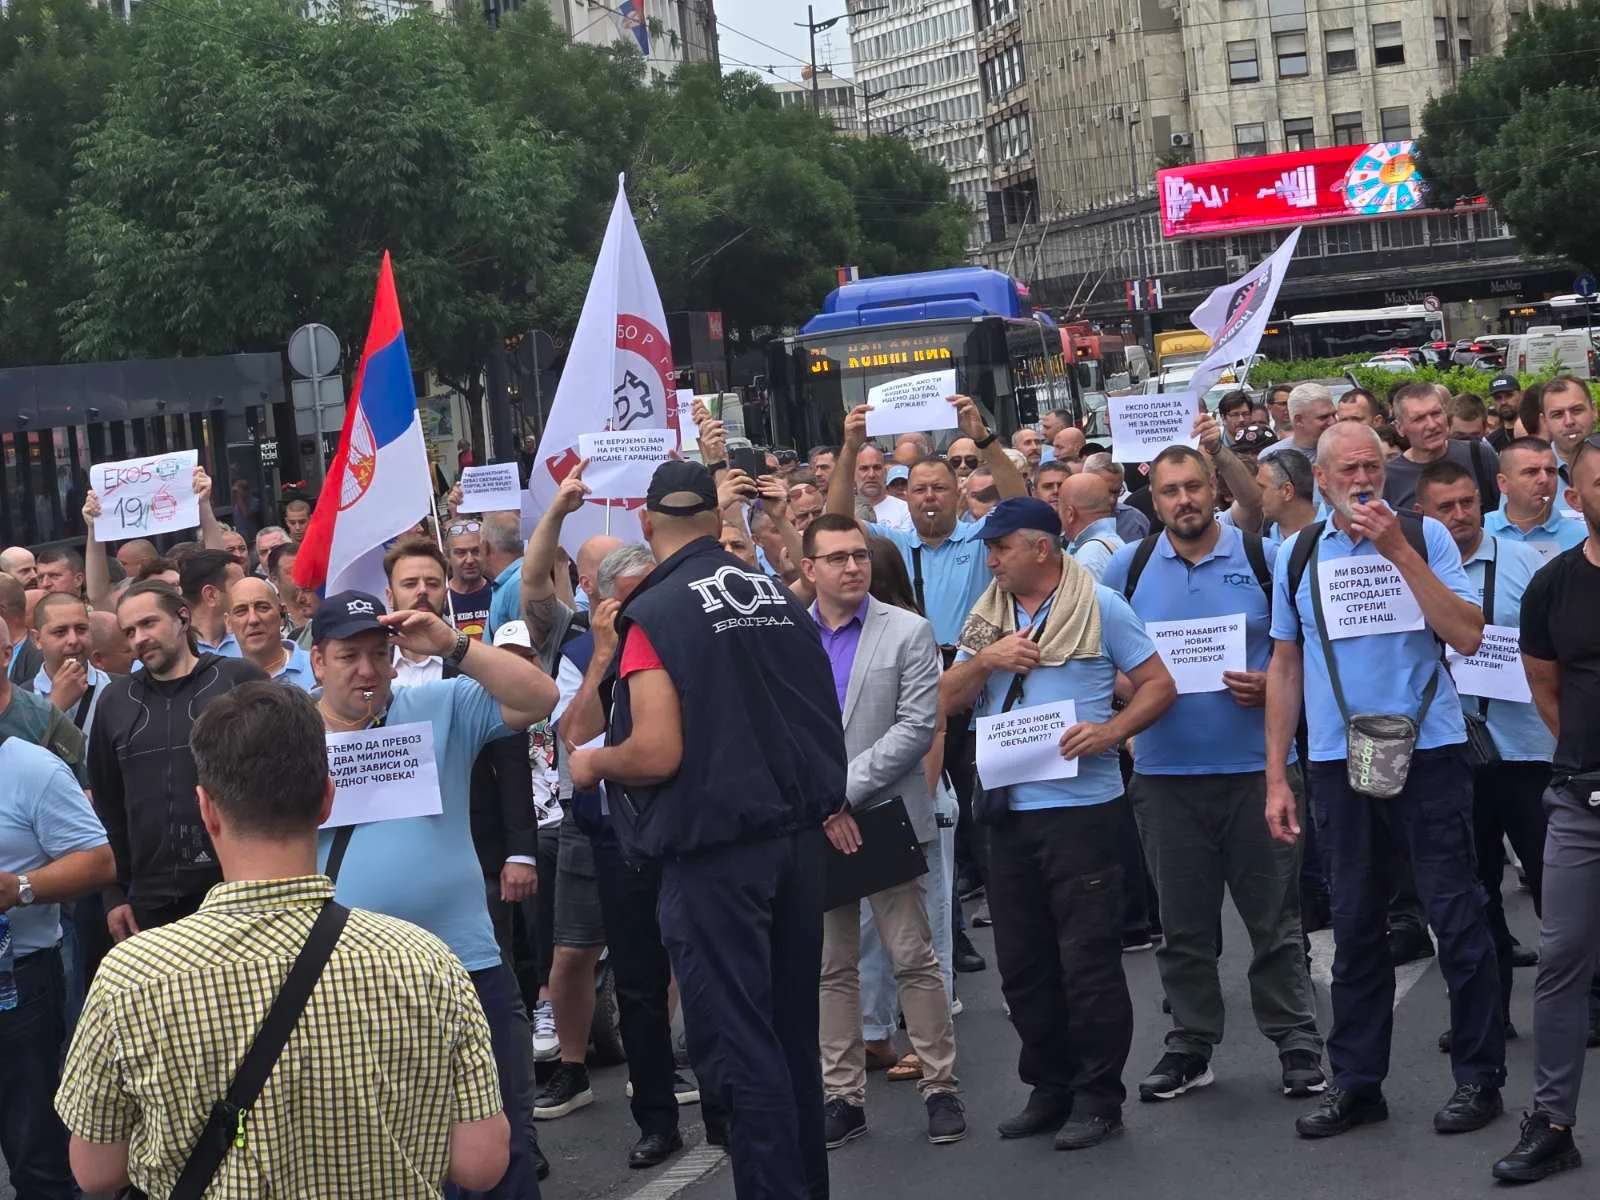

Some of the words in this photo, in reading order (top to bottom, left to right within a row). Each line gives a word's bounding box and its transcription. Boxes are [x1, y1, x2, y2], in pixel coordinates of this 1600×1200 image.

[617, 324, 654, 345] БОР
[921, 391, 940, 399] ВРХА
[1150, 402, 1171, 410] ПЛАН
[1119, 411, 1159, 420] ПРЕПОРОД
[1150, 418, 1183, 427] ПУЊЕЊЕ
[1135, 427, 1179, 436] ПРИВАТНИХ
[593, 438, 605, 446] НЕ
[606, 437, 647, 445] ВЕРУЈЕМО
[590, 455, 621, 463] ПИСАНЕ
[1334, 568, 1349, 577] МИ
[1350, 564, 1393, 575] ВОЗИМО
[1374, 577, 1388, 585] ВИ
[1390, 575, 1401, 583] ГА
[1330, 587, 1402, 603] РАСПРОДАЈЕТЕ
[1346, 601, 1387, 613] СТРЕЛИ!
[1339, 616, 1357, 626] ГСП
[1358, 615, 1369, 625] ЈЕ
[1370, 613, 1397, 623] НАШ.
[1156, 629, 1184, 638] ХИТНО
[1185, 625, 1227, 636] НАБАВИТЕ
[1184, 637, 1213, 646] НОВИХ
[1170, 644, 1226, 656] АУТОНОМНИХ
[1480, 642, 1521, 654] РОЂЕНДА
[1479, 651, 1489, 659] ТИ
[1491, 653, 1517, 663] НАШИ
[991, 721, 1006, 731] ГДЕ
[1006, 719, 1015, 728] ЈЕ
[1016, 717, 1032, 726] 300
[1033, 711, 1061, 722] НОВИХ
[987, 727, 1028, 741] АУТОБУСА
[1029, 723, 1049, 733] КОЈЕ
[1050, 720, 1066, 730] СТЕ
[327, 742, 363, 754] ЕЋЕМО
[365, 740, 380, 751] ДА
[382, 734, 422, 748] ПРЕВОЗ
[1000, 732, 1052, 748] ОБЕЋАЛИ???
[333, 755, 355, 767] ДВА
[357, 748, 410, 762] МИЛИОНА
[1360, 739, 1374, 786] adidas
[359, 760, 401, 773] ЗАВИСИ
[403, 758, 419, 768] ОД
[335, 776, 369, 789] ЕДНОГ
[371, 770, 416, 783] ЧОВЕКА!
